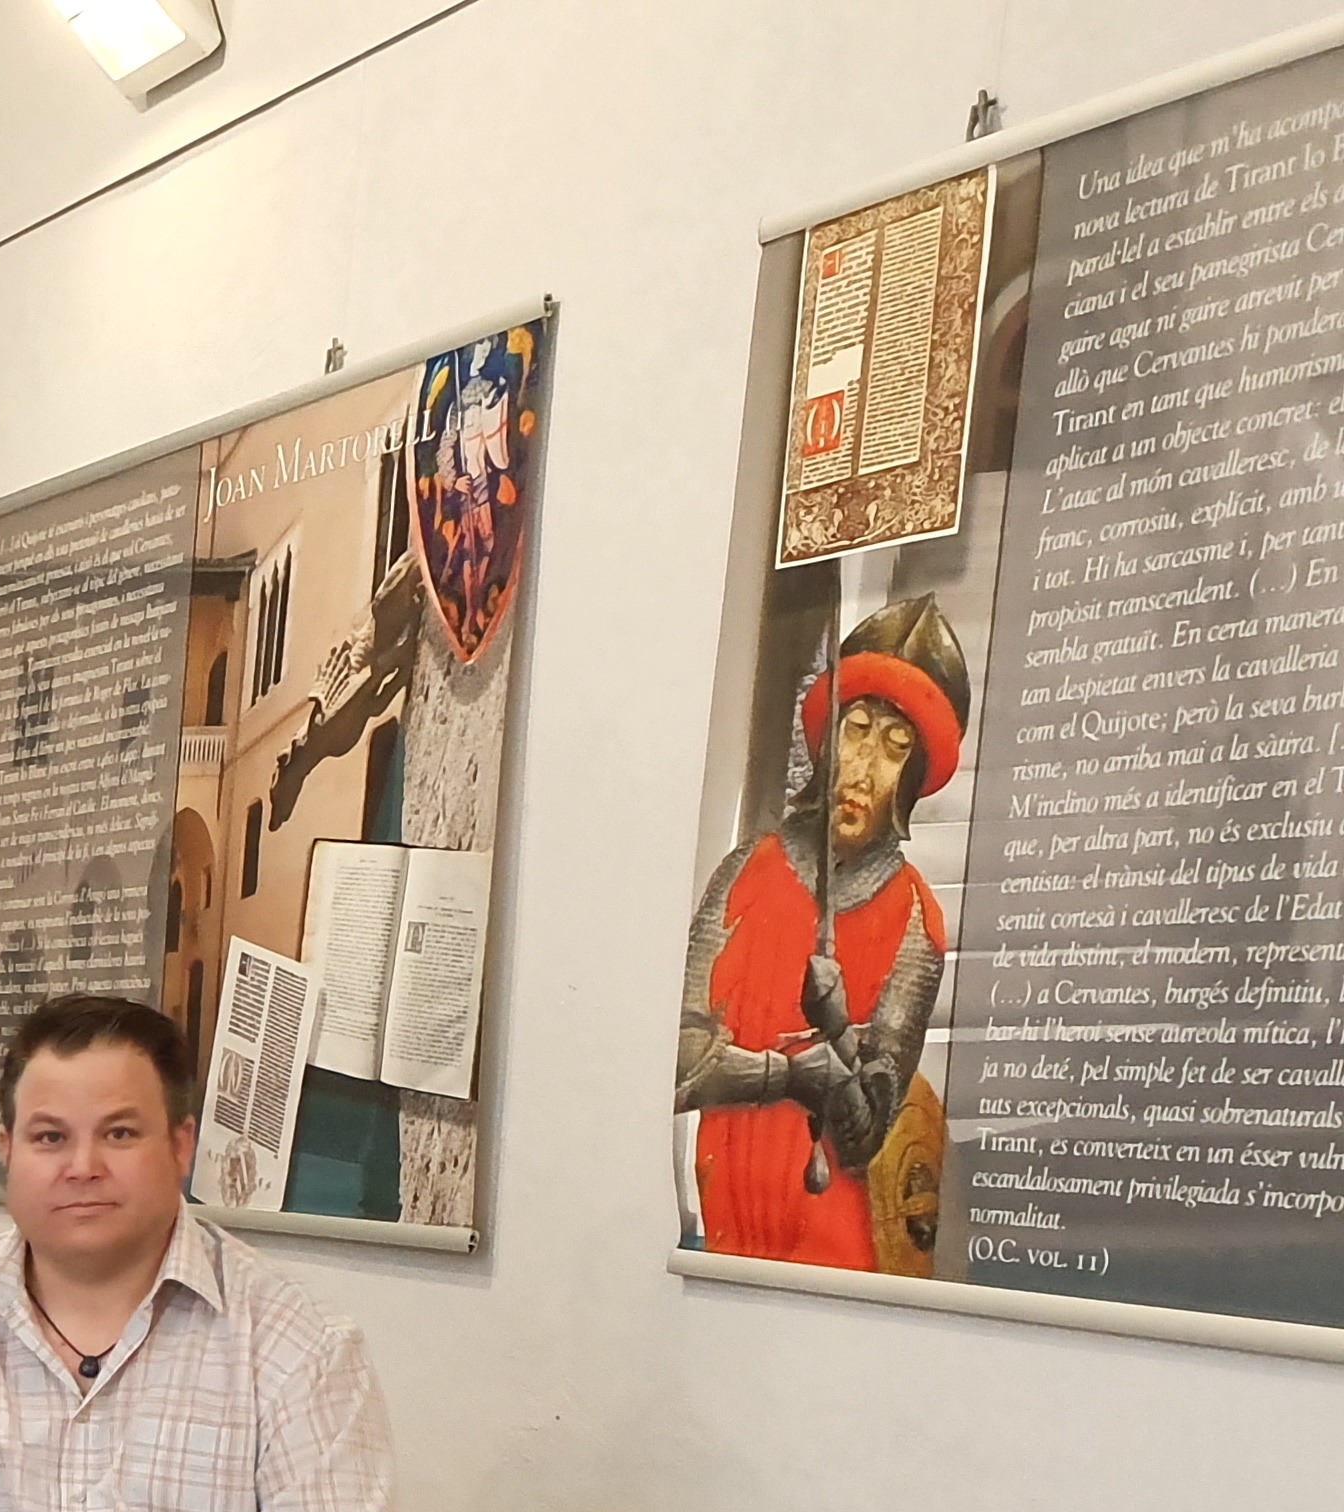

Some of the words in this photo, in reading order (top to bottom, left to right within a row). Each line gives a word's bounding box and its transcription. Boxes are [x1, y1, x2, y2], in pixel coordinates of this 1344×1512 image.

[1078, 170, 1121, 200] Una
[1126, 154, 1165, 185] idea
[1168, 142, 1204, 176] que
[1210, 123, 1262, 157] m'ha
[1074, 214, 1120, 240] nova
[1125, 191, 1189, 226] lectura
[1194, 173, 1219, 203] de
[1225, 156, 1298, 192] Tirant
[1303, 144, 1325, 171] lo
[1064, 292, 1115, 319] ciana
[1120, 282, 1127, 304] i
[1131, 271, 1149, 301] el
[1153, 272, 1184, 297] seu
[1189, 236, 1300, 290] panegirista
[1054, 368, 1090, 398] allò
[1094, 364, 1130, 393] que
[1133, 336, 1235, 378] Cervantes
[1053, 405, 1116, 436] Tirant
[1121, 401, 1145, 421] en
[1150, 390, 1188, 414] tant
[1194, 383, 1232, 410] que
[1045, 445, 1108, 480] aplicat
[1112, 442, 1126, 462] a
[1131, 438, 1156, 458] un
[1162, 421, 1231, 452] objecte
[1027, 599, 1101, 636] propòsit
[1107, 577, 1241, 619] transcendent.
[1305, 557, 1340, 588] En
[1021, 685, 1051, 706] tan
[1055, 672, 1137, 704] despietat
[1142, 665, 1206, 691] envers
[1212, 654, 1231, 681] la
[1236, 644, 1340, 680] cavalleria
[1016, 721, 1055, 744] com
[1060, 714, 1077, 740] el
[1081, 710, 1168, 740] Quijote;
[1172, 701, 1218, 734] però
[1225, 694, 1244, 720] la
[1250, 695, 1296, 719] seva
[996, 907, 1046, 932] sentit
[1050, 901, 1114, 929] cortesà
[1120, 903, 1129, 926] i
[1132, 897, 1240, 927] cavalleresc
[1244, 895, 1269, 923] de
[1275, 892, 1343, 921] l'Edat
[1037, 986, 1050, 1005] a
[1054, 980, 1157, 1007] Cervantes,
[1164, 978, 1230, 1010] burgés
[1234, 976, 1331, 1010] definitiu,
[978, 1056, 999, 1084] ja
[1003, 1061, 1027, 1080] no
[1031, 1054, 1075, 1082] deté,
[1079, 1055, 1111, 1086] pel
[1114, 1059, 1175, 1088] simple
[1177, 1057, 1207, 1089] fet
[1212, 1059, 1236, 1085] de
[1241, 1067, 1274, 1086] ser
[979, 1097, 1011, 1116] tuts
[1016, 1094, 1136, 1124] excepcionals,
[1143, 1100, 1197, 1127] quasi
[1199, 1098, 1343, 1129] sobrenaturals
[972, 1166, 1123, 1197] escandalosament
[1127, 1176, 1240, 1208] privilegiada
[969, 1203, 1067, 1231] normalitat.
[967, 1236, 1020, 1264] (O.C.
